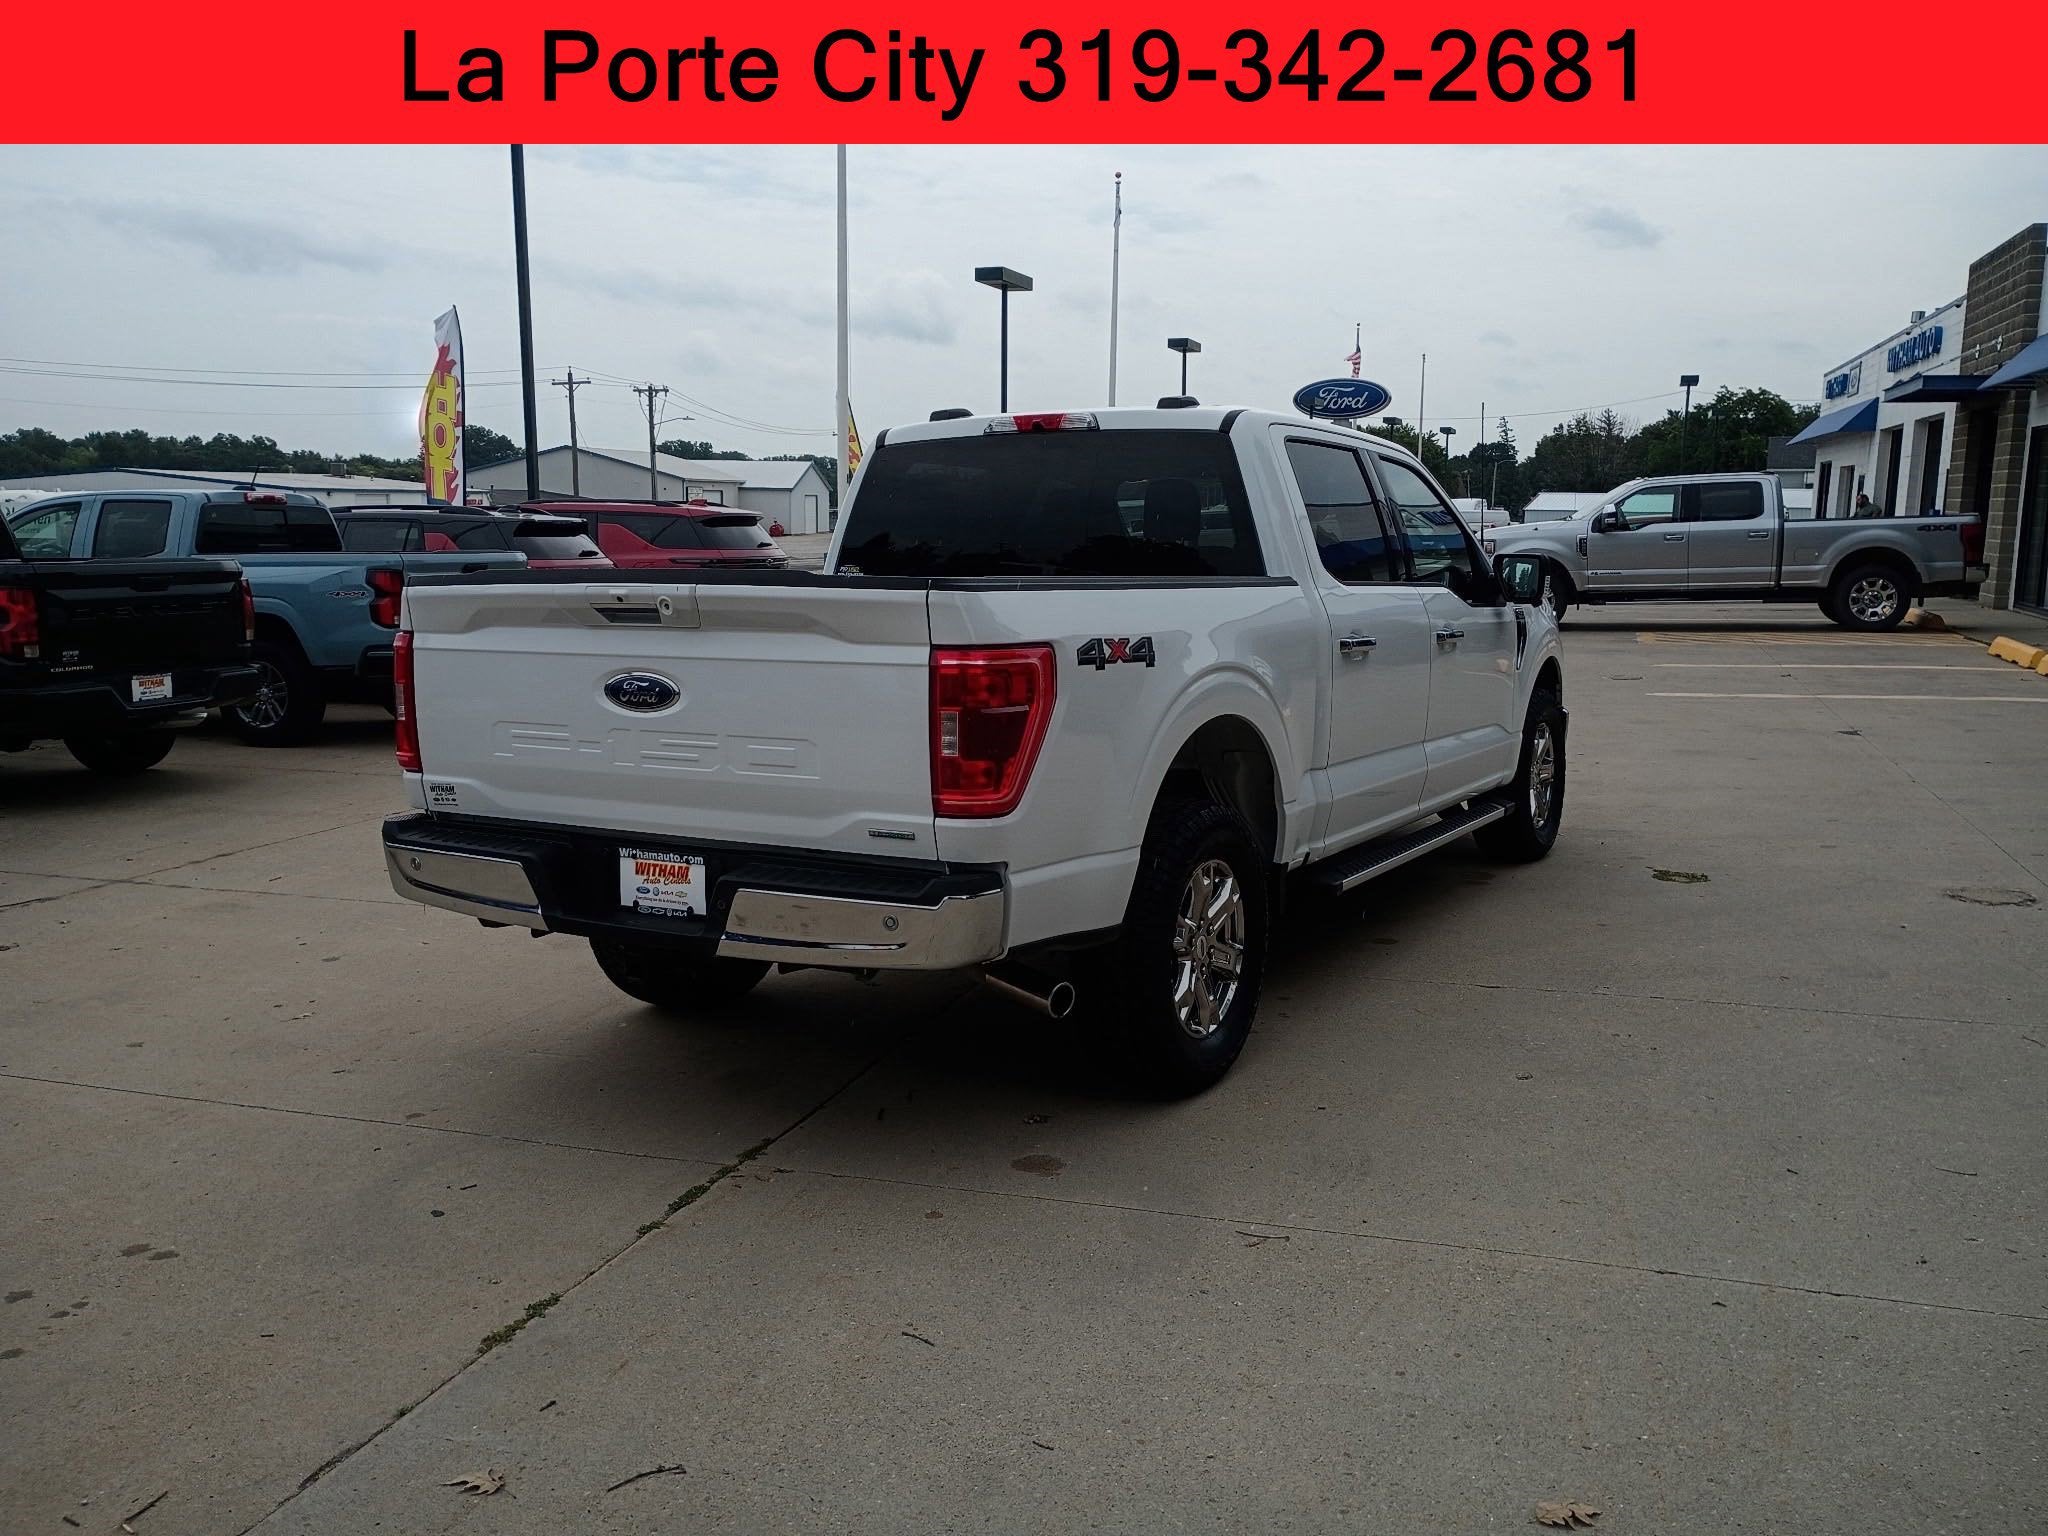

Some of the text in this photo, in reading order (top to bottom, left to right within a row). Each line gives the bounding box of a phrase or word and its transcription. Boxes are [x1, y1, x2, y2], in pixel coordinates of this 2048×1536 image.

[1319, 386, 1369, 409] Ford
[493, 720, 821, 779] F-150
[634, 861, 690, 881] WITHAM
